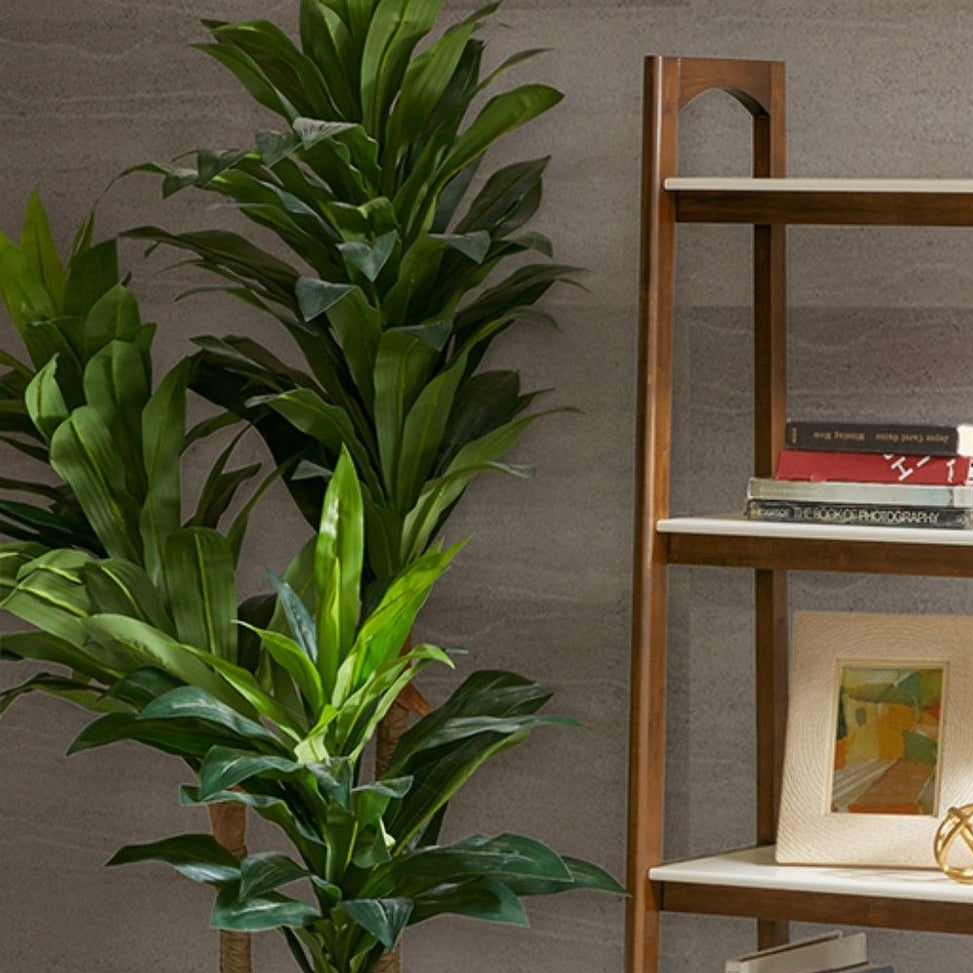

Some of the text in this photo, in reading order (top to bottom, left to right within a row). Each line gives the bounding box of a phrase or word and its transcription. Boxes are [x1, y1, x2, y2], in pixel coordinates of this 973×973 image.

[793, 508, 814, 519] THE
[813, 508, 841, 521] BOOK
[841, 510, 857, 522] OF
[857, 510, 940, 524] PHOTOGRAPHY
